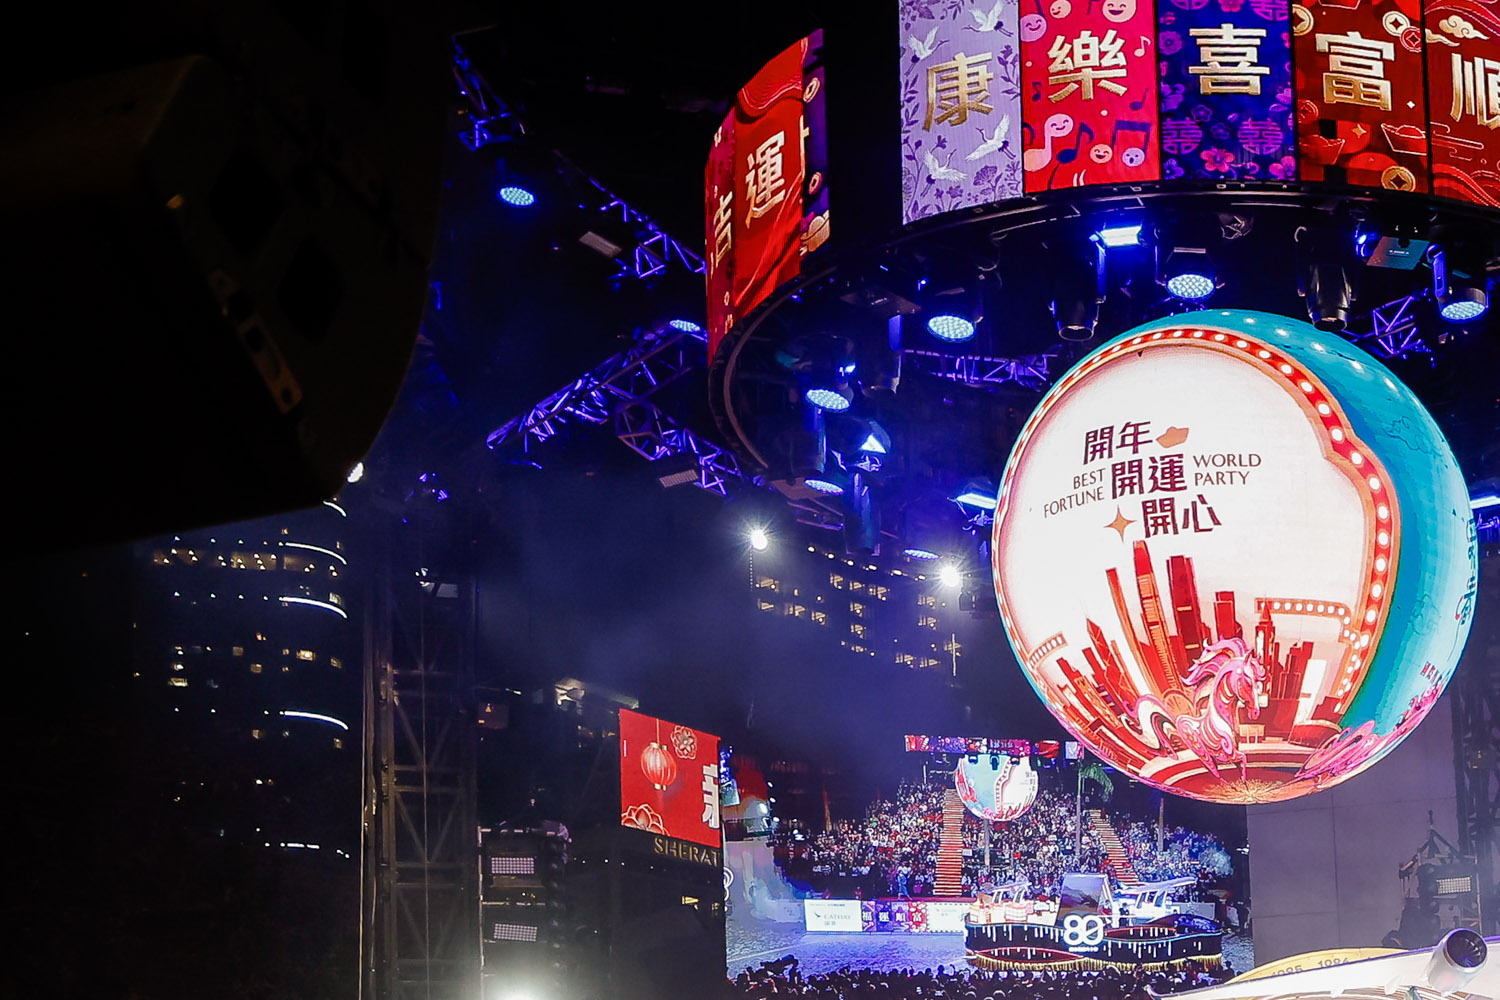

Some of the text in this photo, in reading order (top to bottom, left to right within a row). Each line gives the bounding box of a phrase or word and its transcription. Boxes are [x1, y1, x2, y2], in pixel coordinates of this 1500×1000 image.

[922, 51, 996, 132] 康
[1047, 30, 1128, 103] 樂
[1189, 23, 1270, 96] 喜
[1316, 31, 1395, 111] 富
[713, 130, 786, 269] 吉 運
[1083, 421, 1153, 465] 開年
[1111, 453, 1188, 500] 開運
[1193, 453, 1262, 468] WORLD
[1073, 467, 1106, 490] BEST
[1194, 471, 1250, 486] PARTY
[1043, 486, 1105, 518] FORTUNE
[1141, 494, 1222, 539] 開心
[654, 837, 721, 867] SHERAT
[1063, 914, 1104, 946] 80
